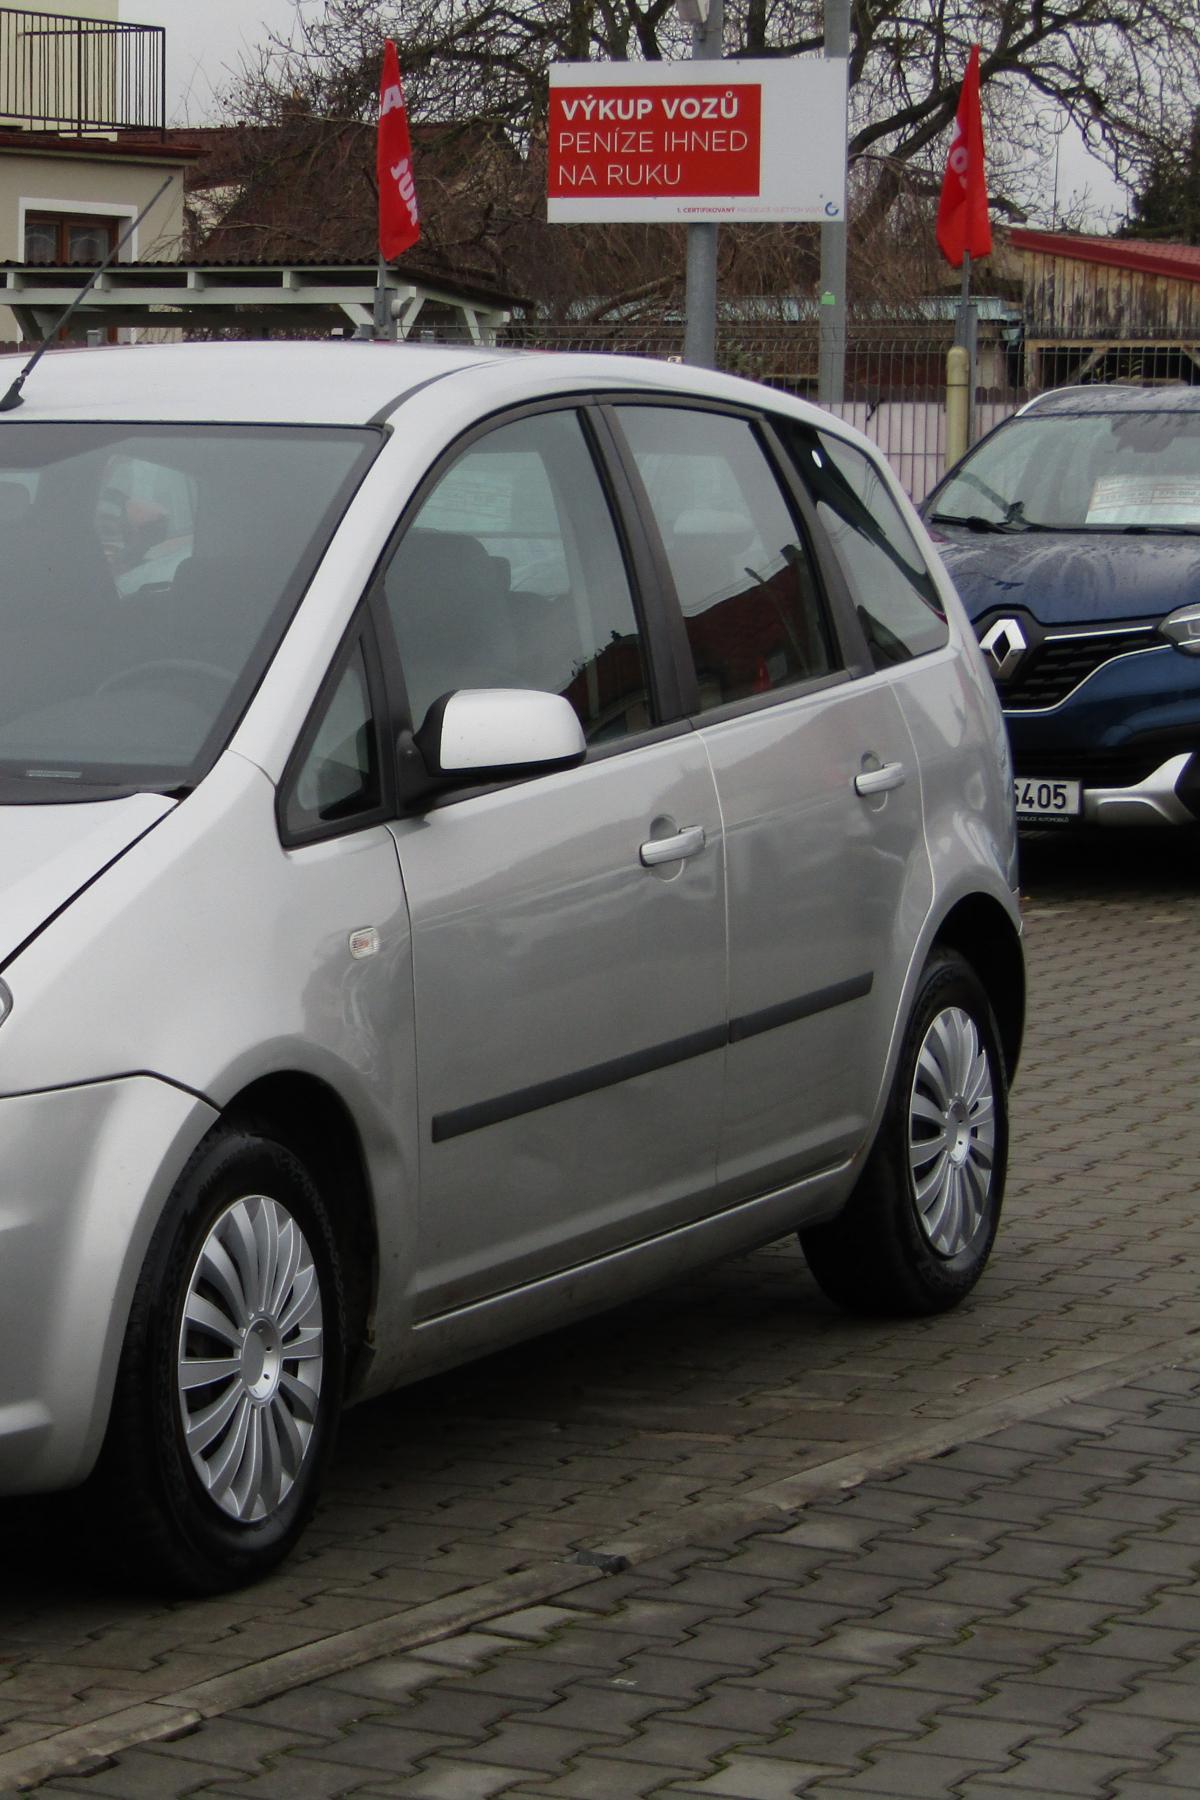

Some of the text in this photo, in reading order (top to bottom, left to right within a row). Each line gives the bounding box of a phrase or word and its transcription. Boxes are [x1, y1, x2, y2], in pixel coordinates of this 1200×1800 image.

[560, 91, 739, 121] VÝKUP VOZŮ
[559, 127, 748, 153] PENÍZE IHNED
[558, 163, 682, 186] NA RUKU
